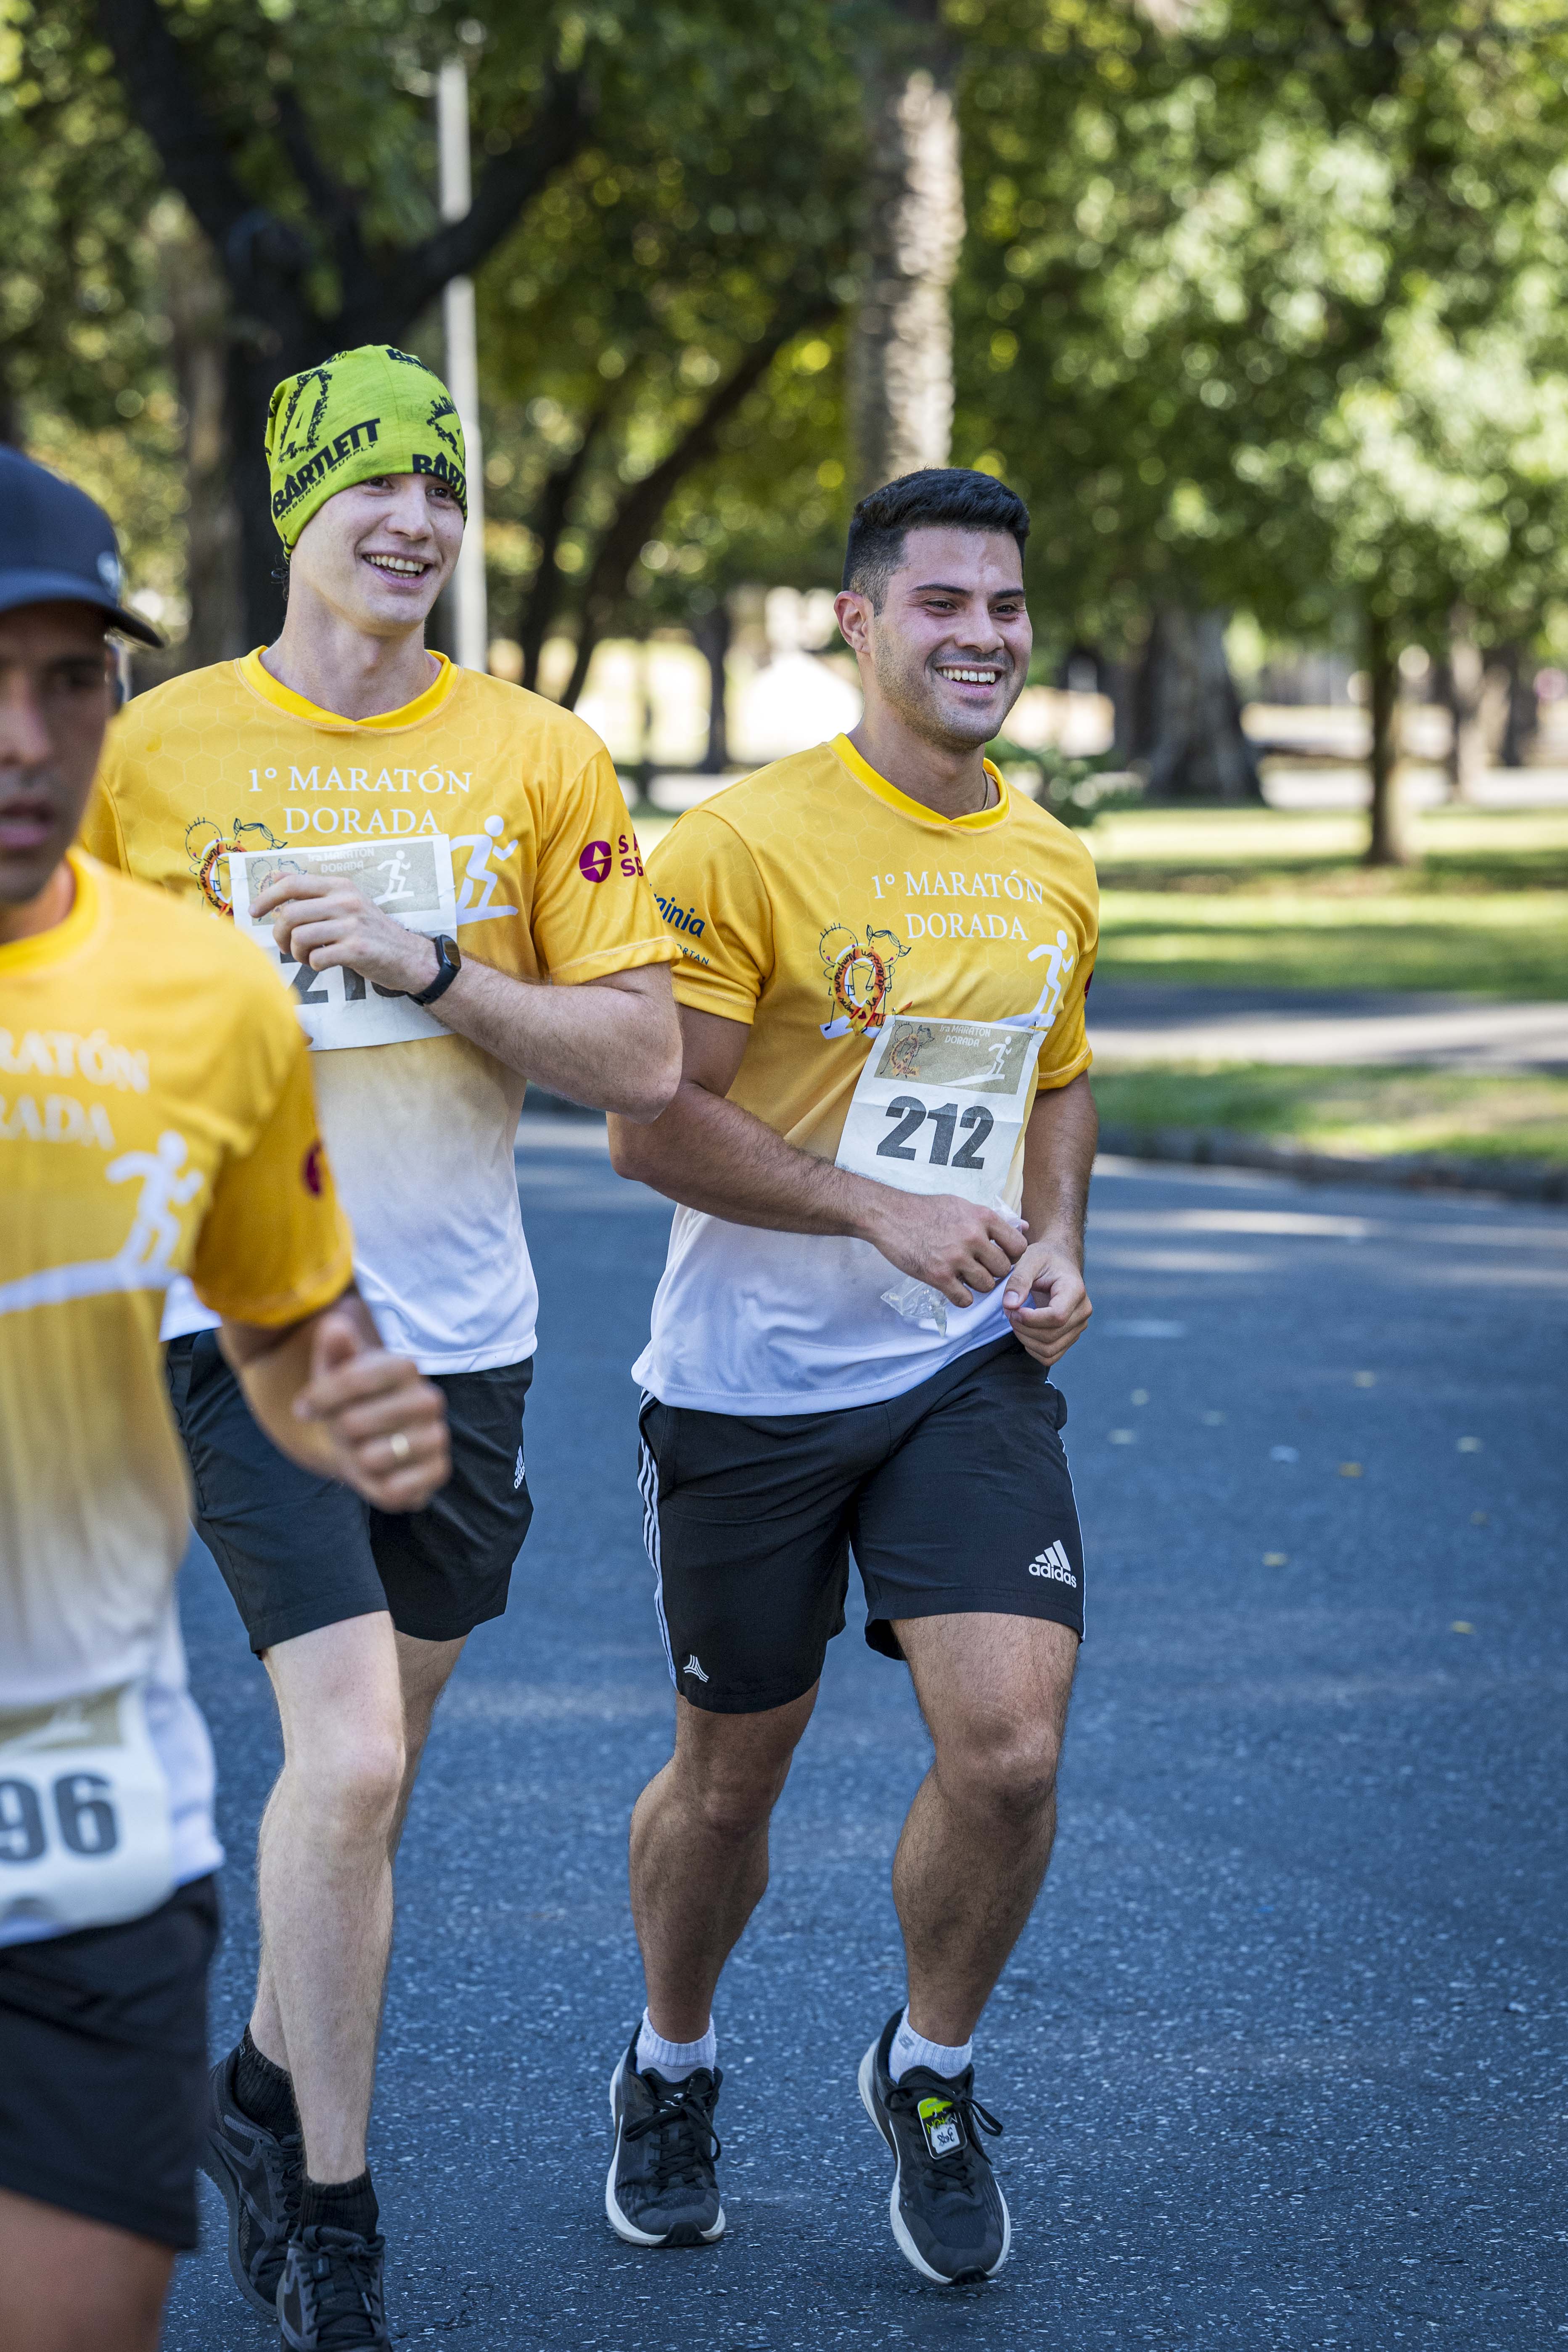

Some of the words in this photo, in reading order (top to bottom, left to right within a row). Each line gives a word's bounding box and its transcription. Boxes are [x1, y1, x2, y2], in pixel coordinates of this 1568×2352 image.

[272, 418, 381, 520] BARTLETT
[280, 474, 326, 521] ARBORIST
[331, 442, 375, 473] SUPPLY
[288, 764, 473, 794] MARATÓN
[283, 807, 442, 835] DORADA
[321, 861, 364, 873] DORADA
[904, 870, 1043, 905] MARATÓN
[904, 913, 1029, 941] DORADA
[945, 1035, 980, 1047] DORADA
[951, 1025, 991, 1037] MARATON
[876, 1096, 994, 1169] 212
[1029, 1563, 1077, 1588] adidas
[0, 1773, 120, 1860] 96
